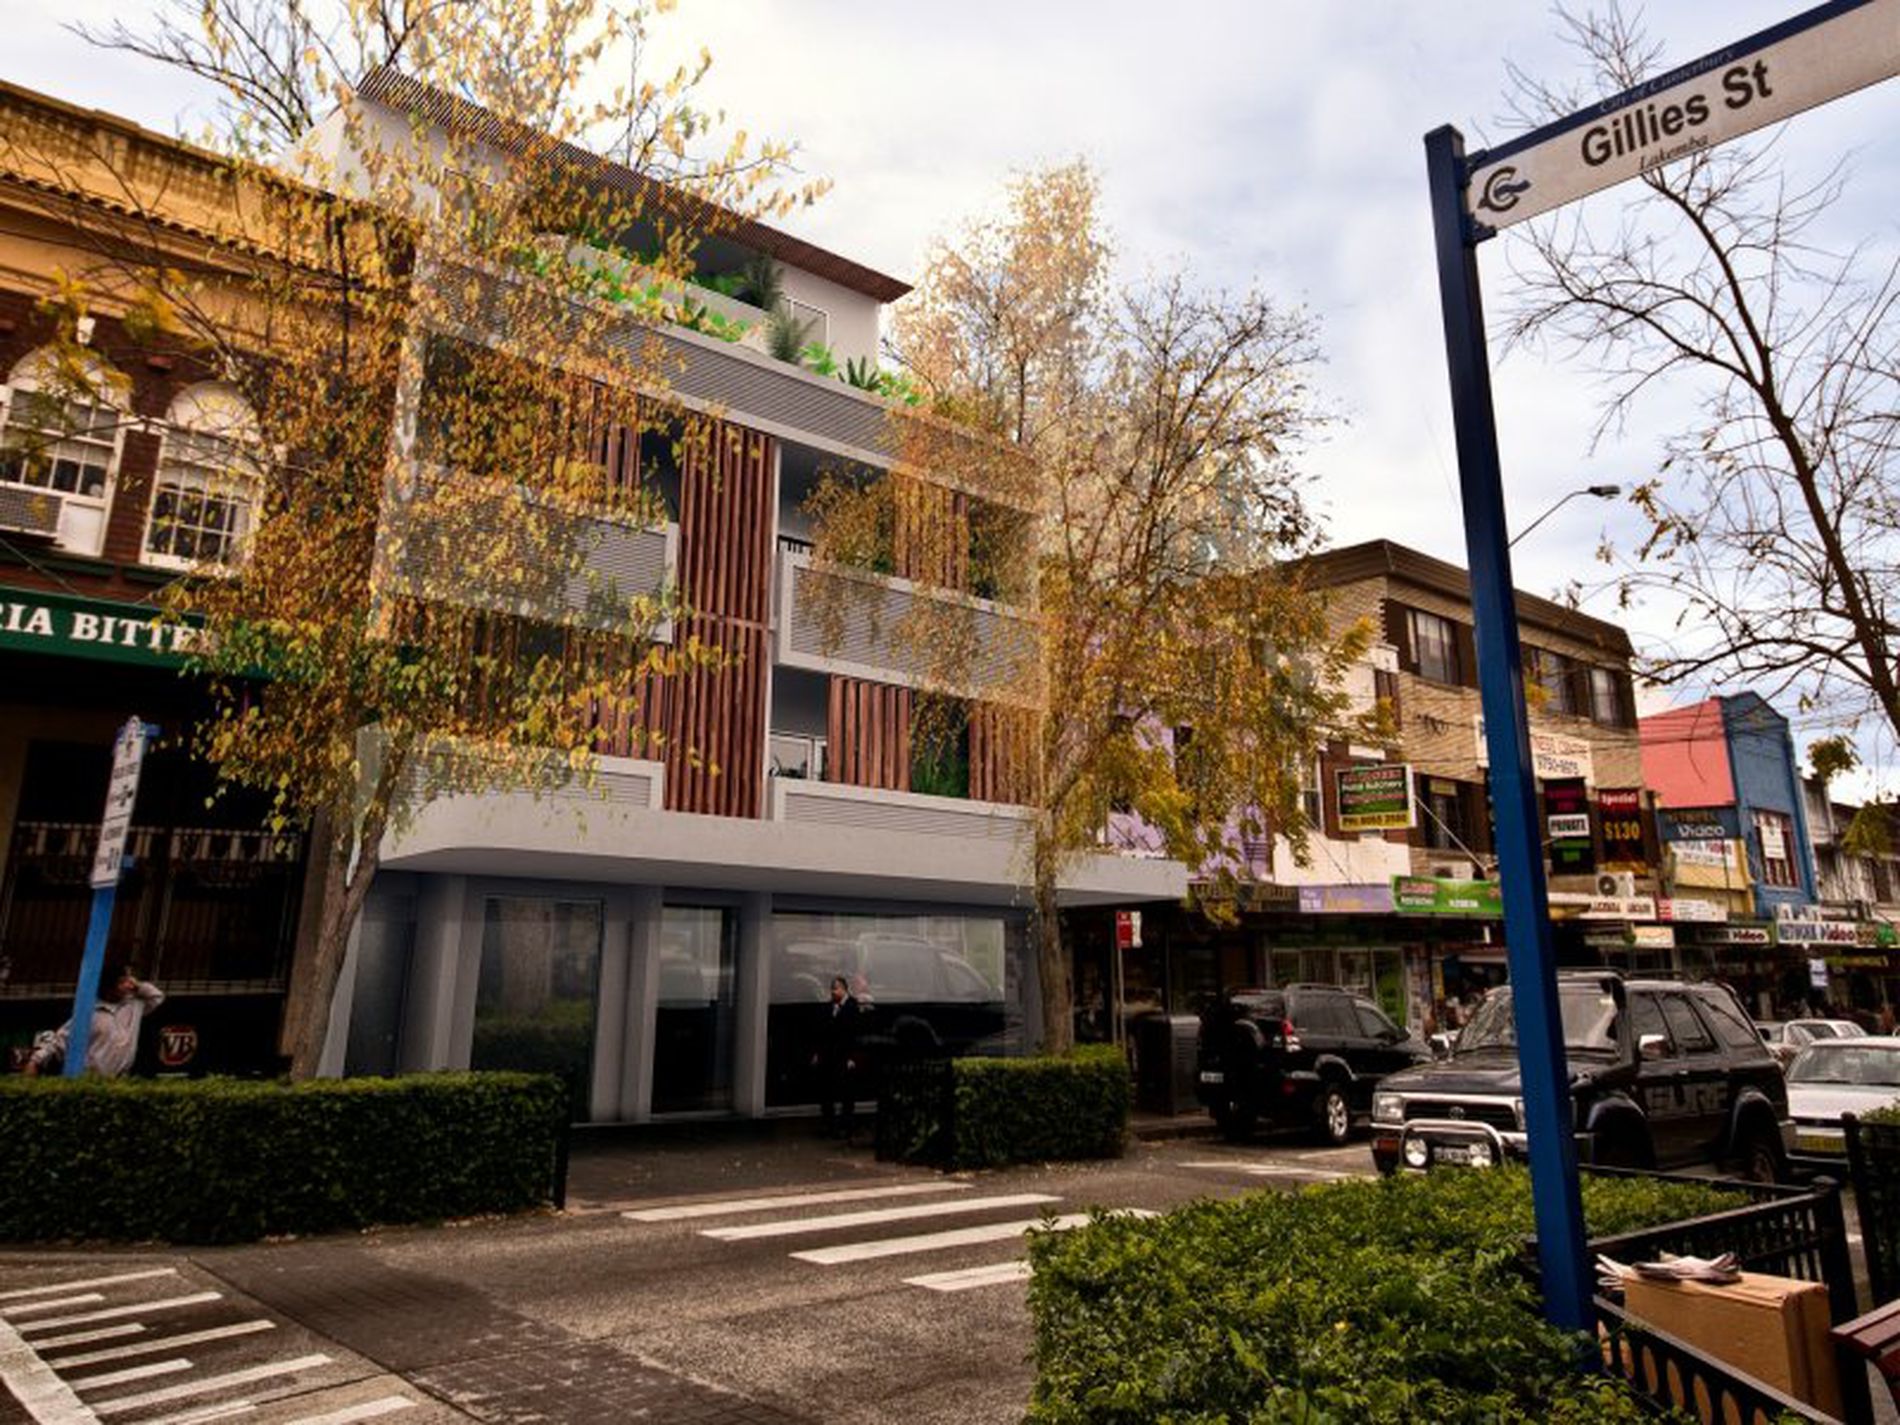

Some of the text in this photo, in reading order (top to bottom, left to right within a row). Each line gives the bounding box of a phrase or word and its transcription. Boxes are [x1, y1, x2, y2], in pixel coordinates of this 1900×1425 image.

[1650, 48, 1733, 91] Canterbury
[1581, 59, 1772, 167] Gillies St
[1639, 133, 1709, 170] Lakemba
[70, 612, 207, 653] BITTE
[1604, 821, 1640, 839] $130
[1676, 824, 1725, 837] Video
[1733, 928, 1766, 941] Video
[161, 1033, 194, 1051] VB
